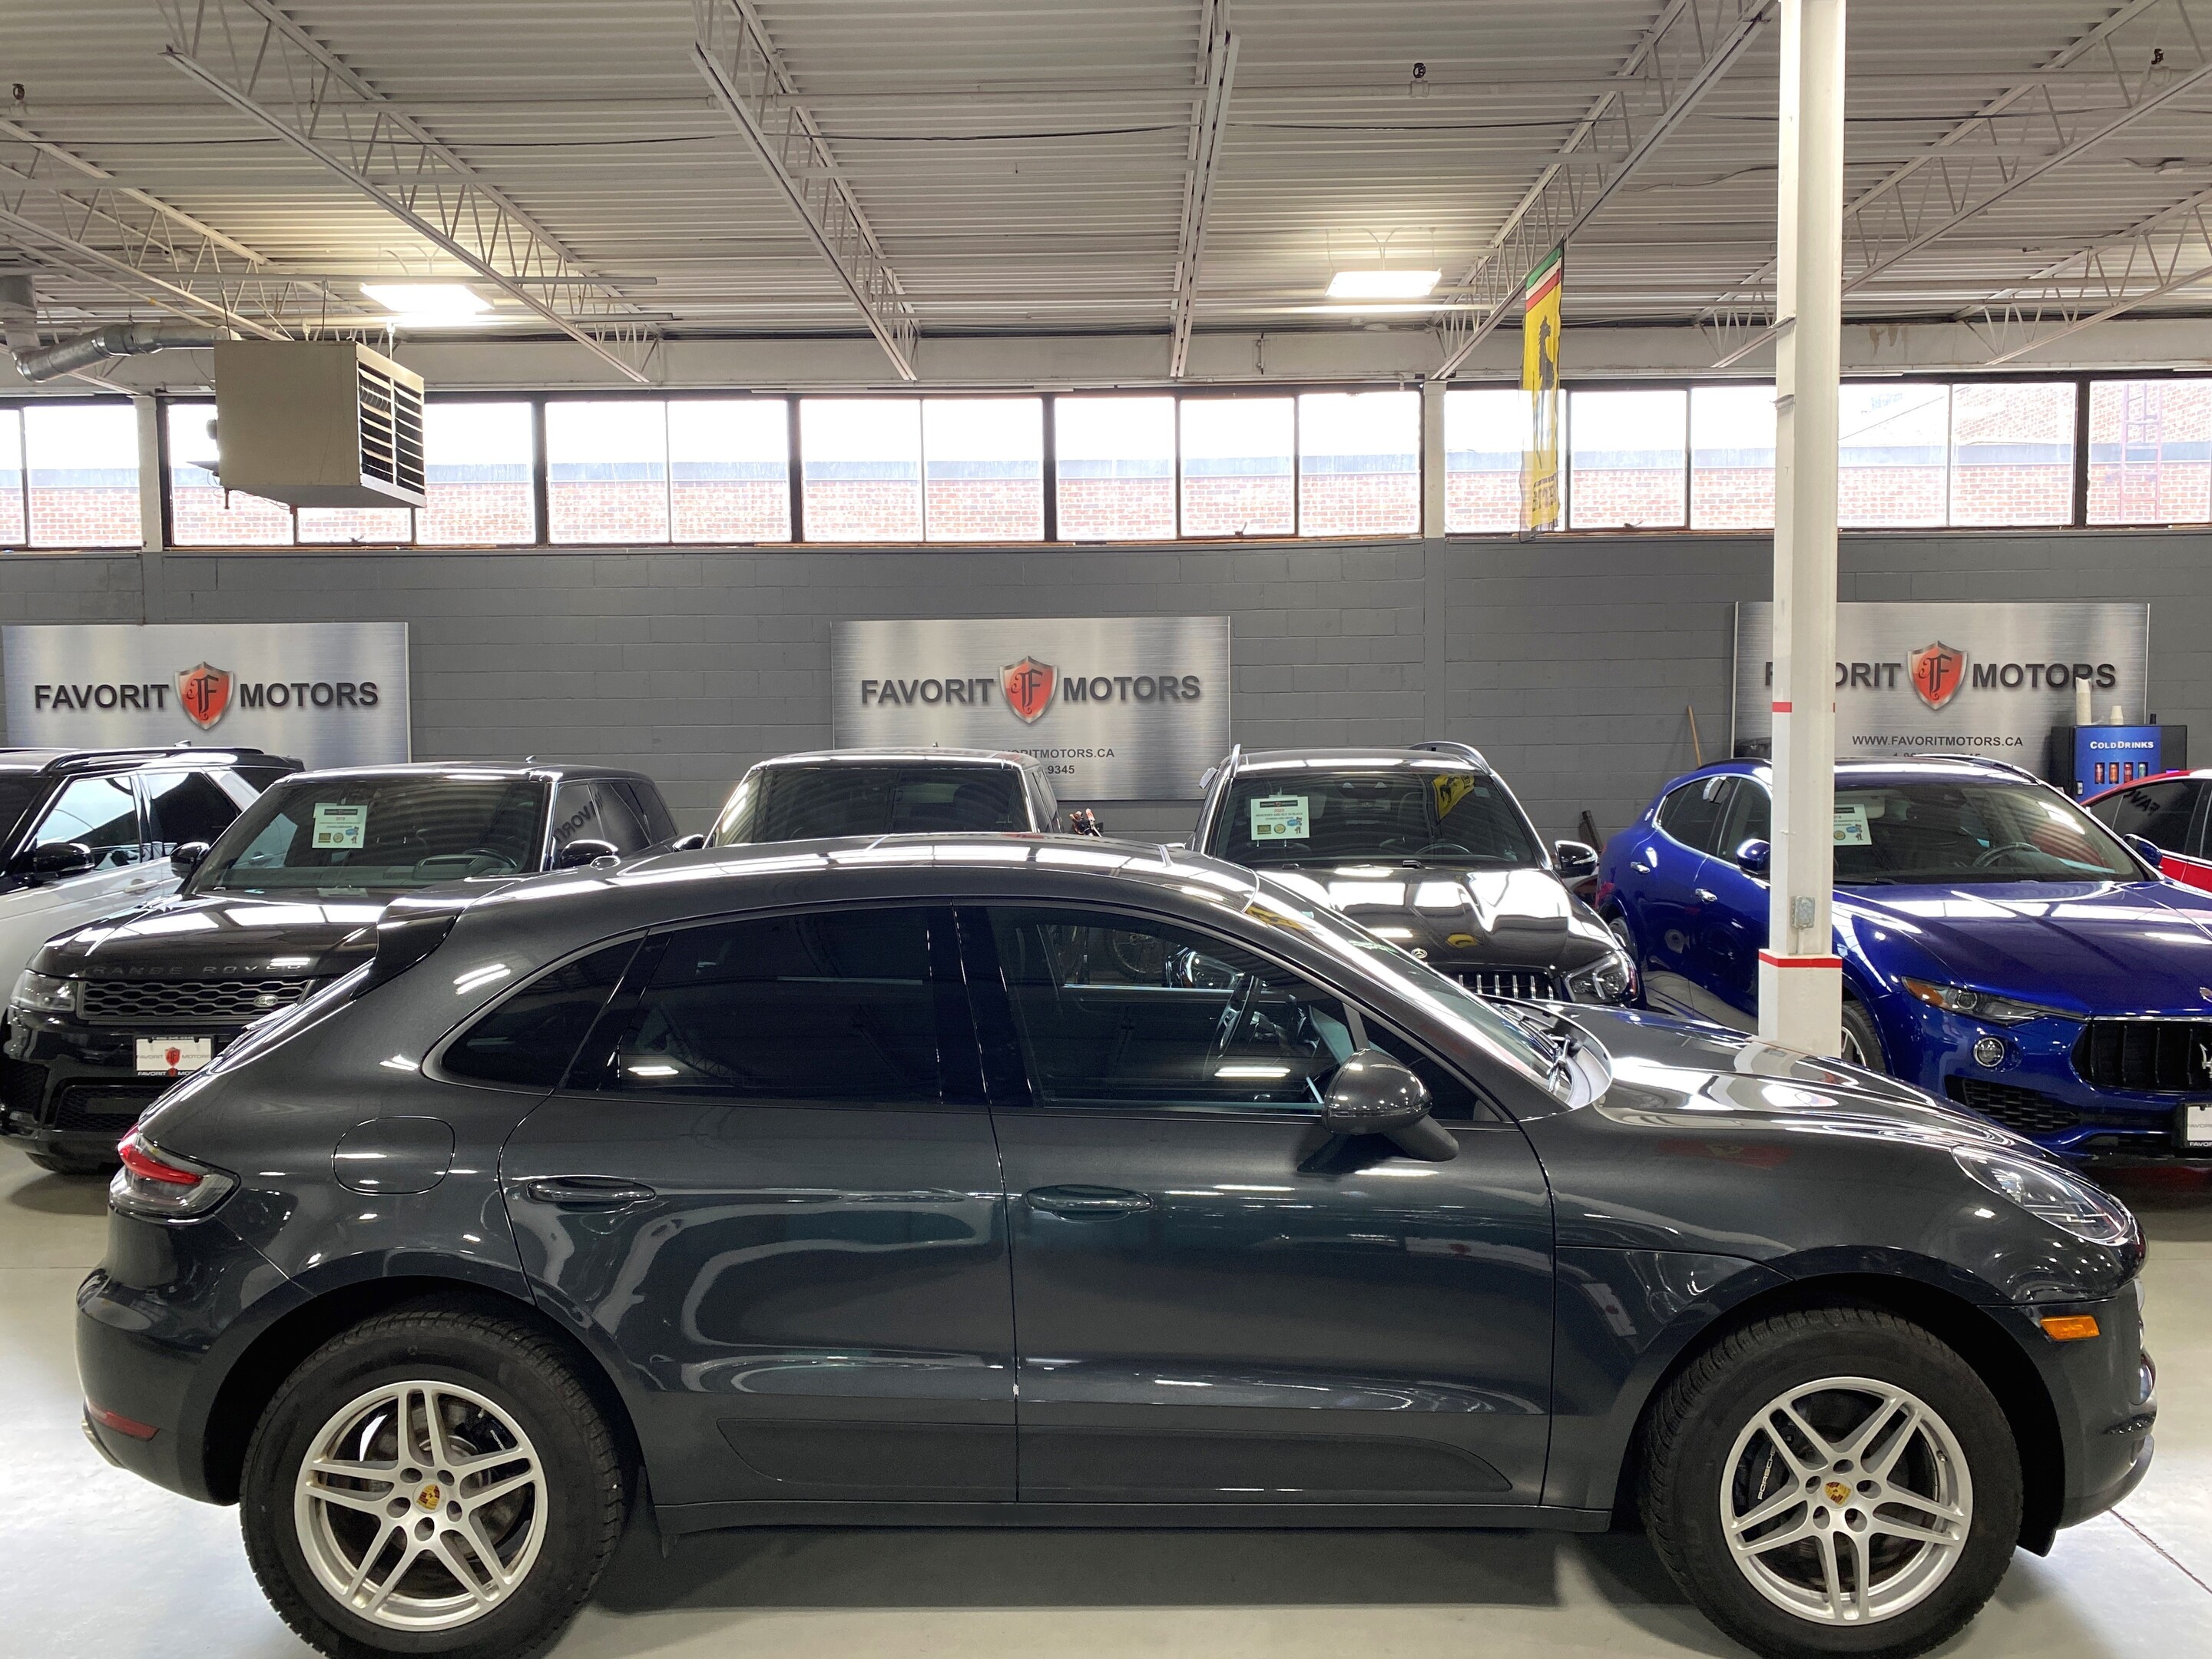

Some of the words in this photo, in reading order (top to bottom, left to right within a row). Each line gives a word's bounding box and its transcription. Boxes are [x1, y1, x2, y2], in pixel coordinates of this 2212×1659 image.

[1972, 663, 2116, 688] MOTORS
[35, 684, 169, 709] FAVORIT
[240, 682, 379, 707] MOTORS
[862, 679, 994, 704] FAVORIT
[1063, 676, 1200, 701] MOTORS
[1853, 736, 2023, 747] WWW.FAVORITMOTORS.CA
[93, 965, 184, 975] RANGE
[203, 965, 302, 975] ROVER
